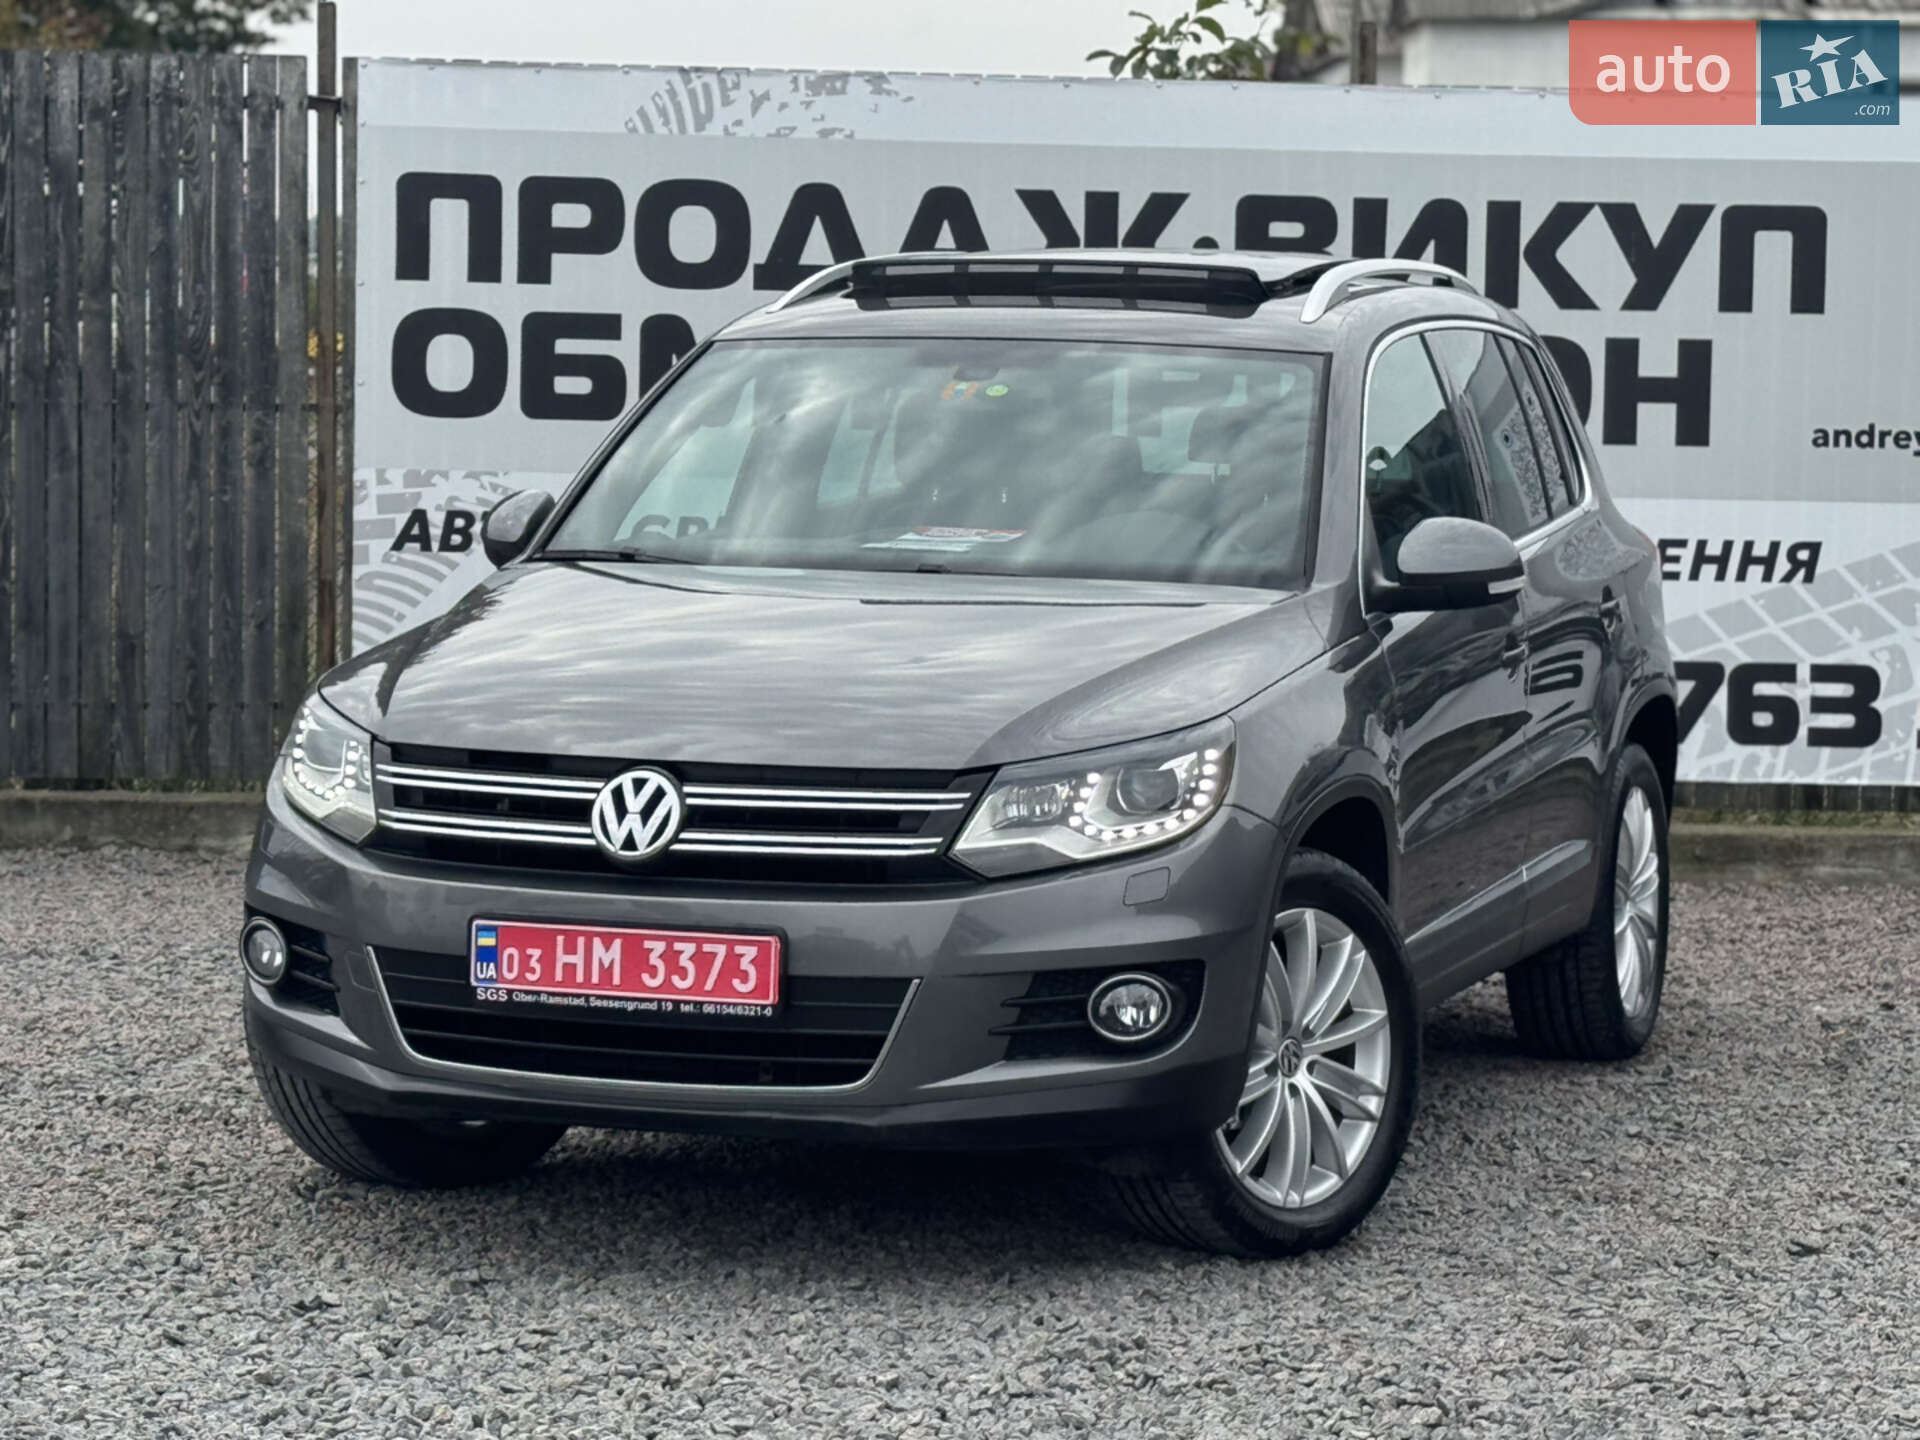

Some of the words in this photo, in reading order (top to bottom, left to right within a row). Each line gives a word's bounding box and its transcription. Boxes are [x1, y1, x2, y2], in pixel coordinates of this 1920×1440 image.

[592, 770, 681, 856] VW
[476, 961, 497, 979] UA
[502, 947, 542, 982] 03
[555, 935, 622, 986] HM
[641, 940, 758, 993] 3373
[476, 988, 508, 1001] SGS
[661, 1001, 673, 1012] 19
